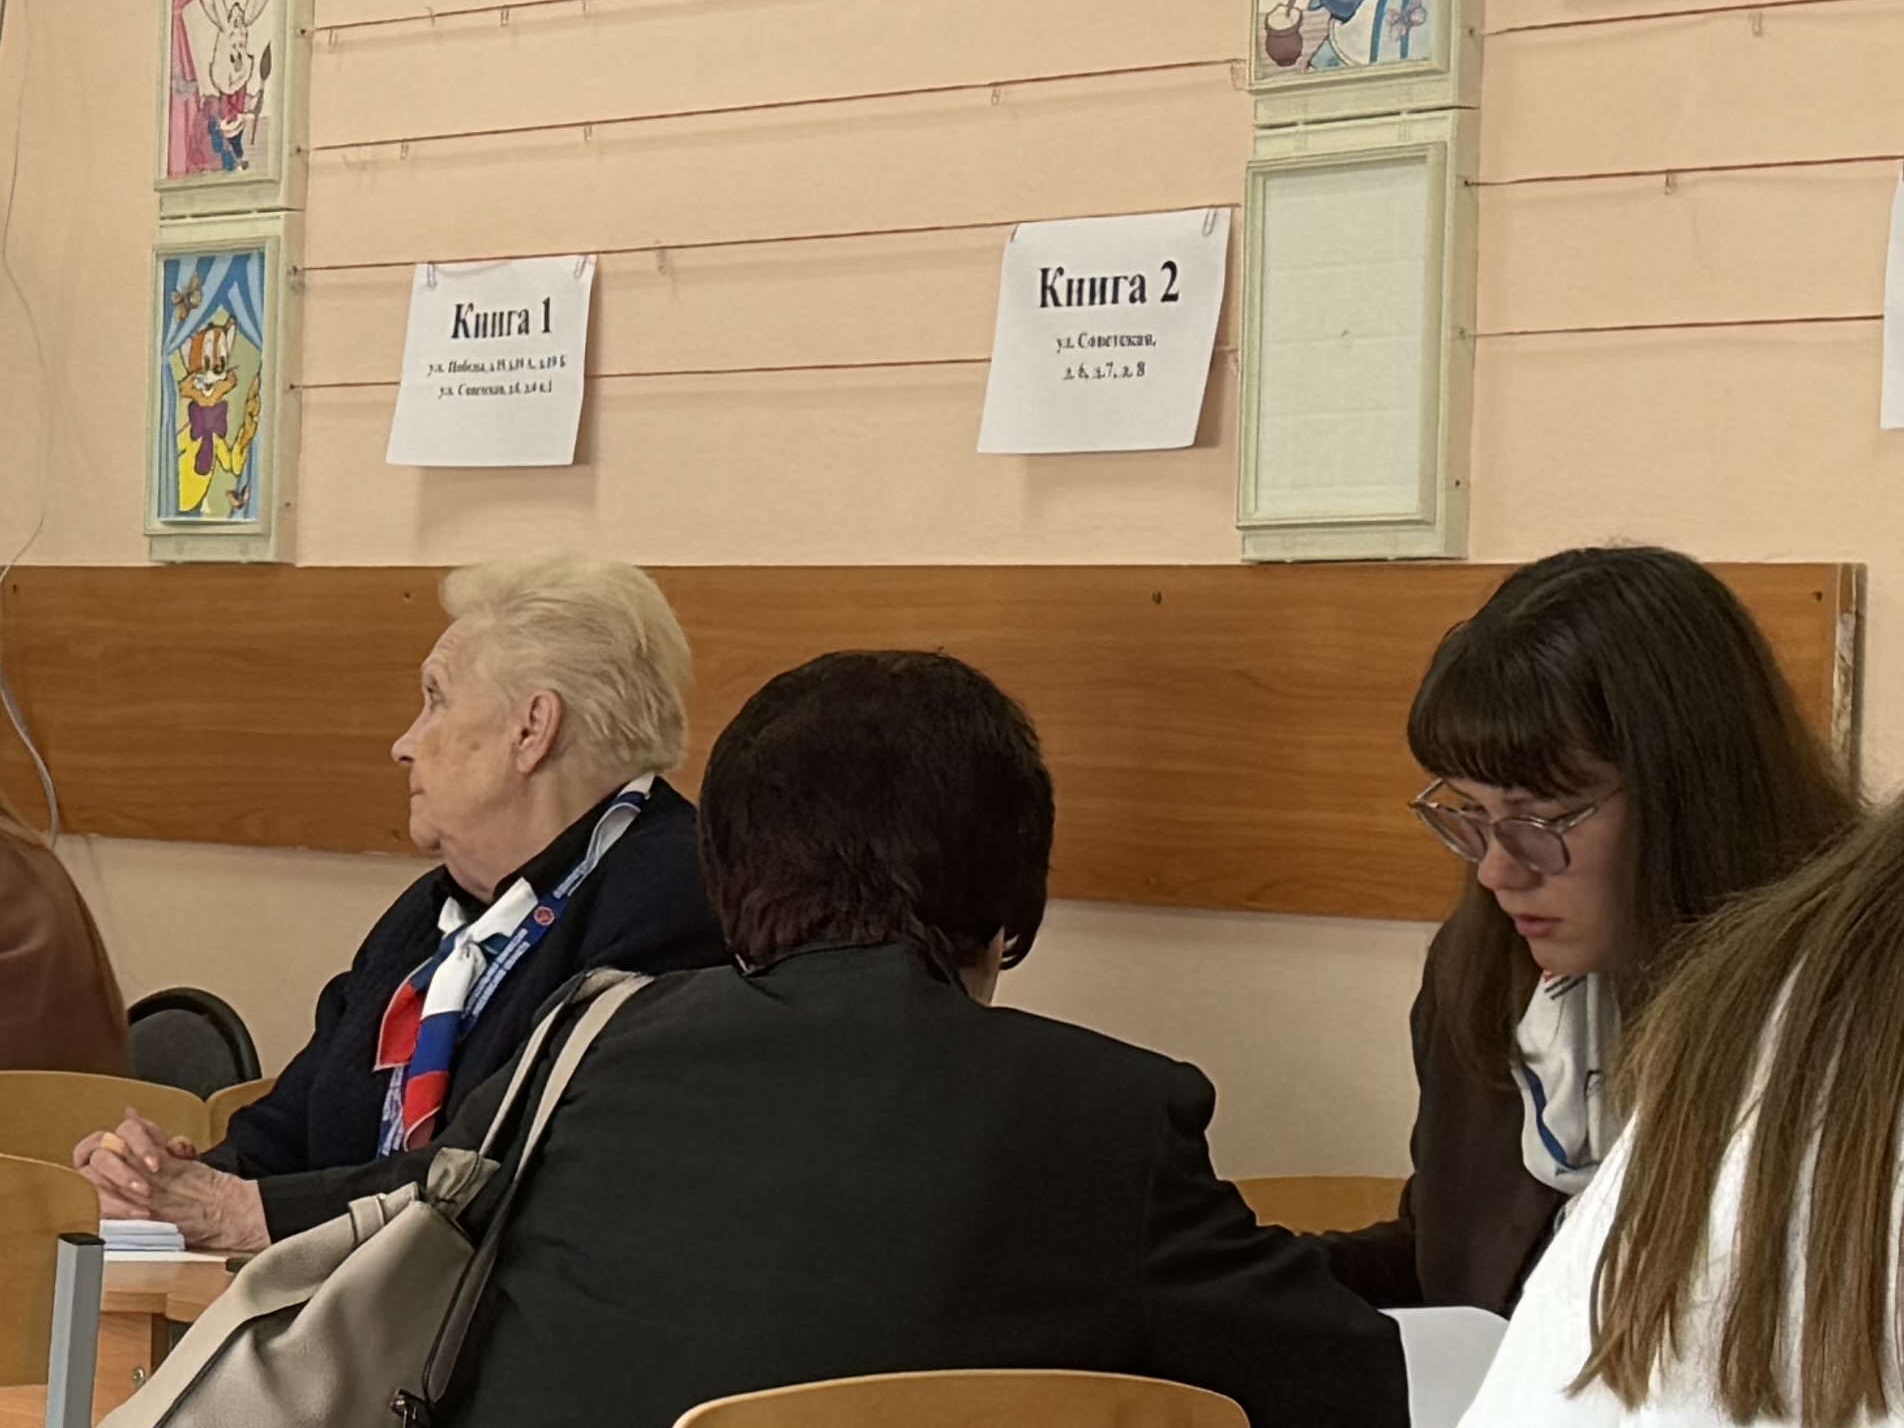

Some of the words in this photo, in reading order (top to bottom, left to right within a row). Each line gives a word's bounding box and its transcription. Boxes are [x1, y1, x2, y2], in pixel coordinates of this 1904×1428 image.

[1038, 266, 1147, 308] Книга
[1160, 260, 1180, 303] 2
[451, 302, 530, 339] Книга
[542, 297, 552, 334] 1
